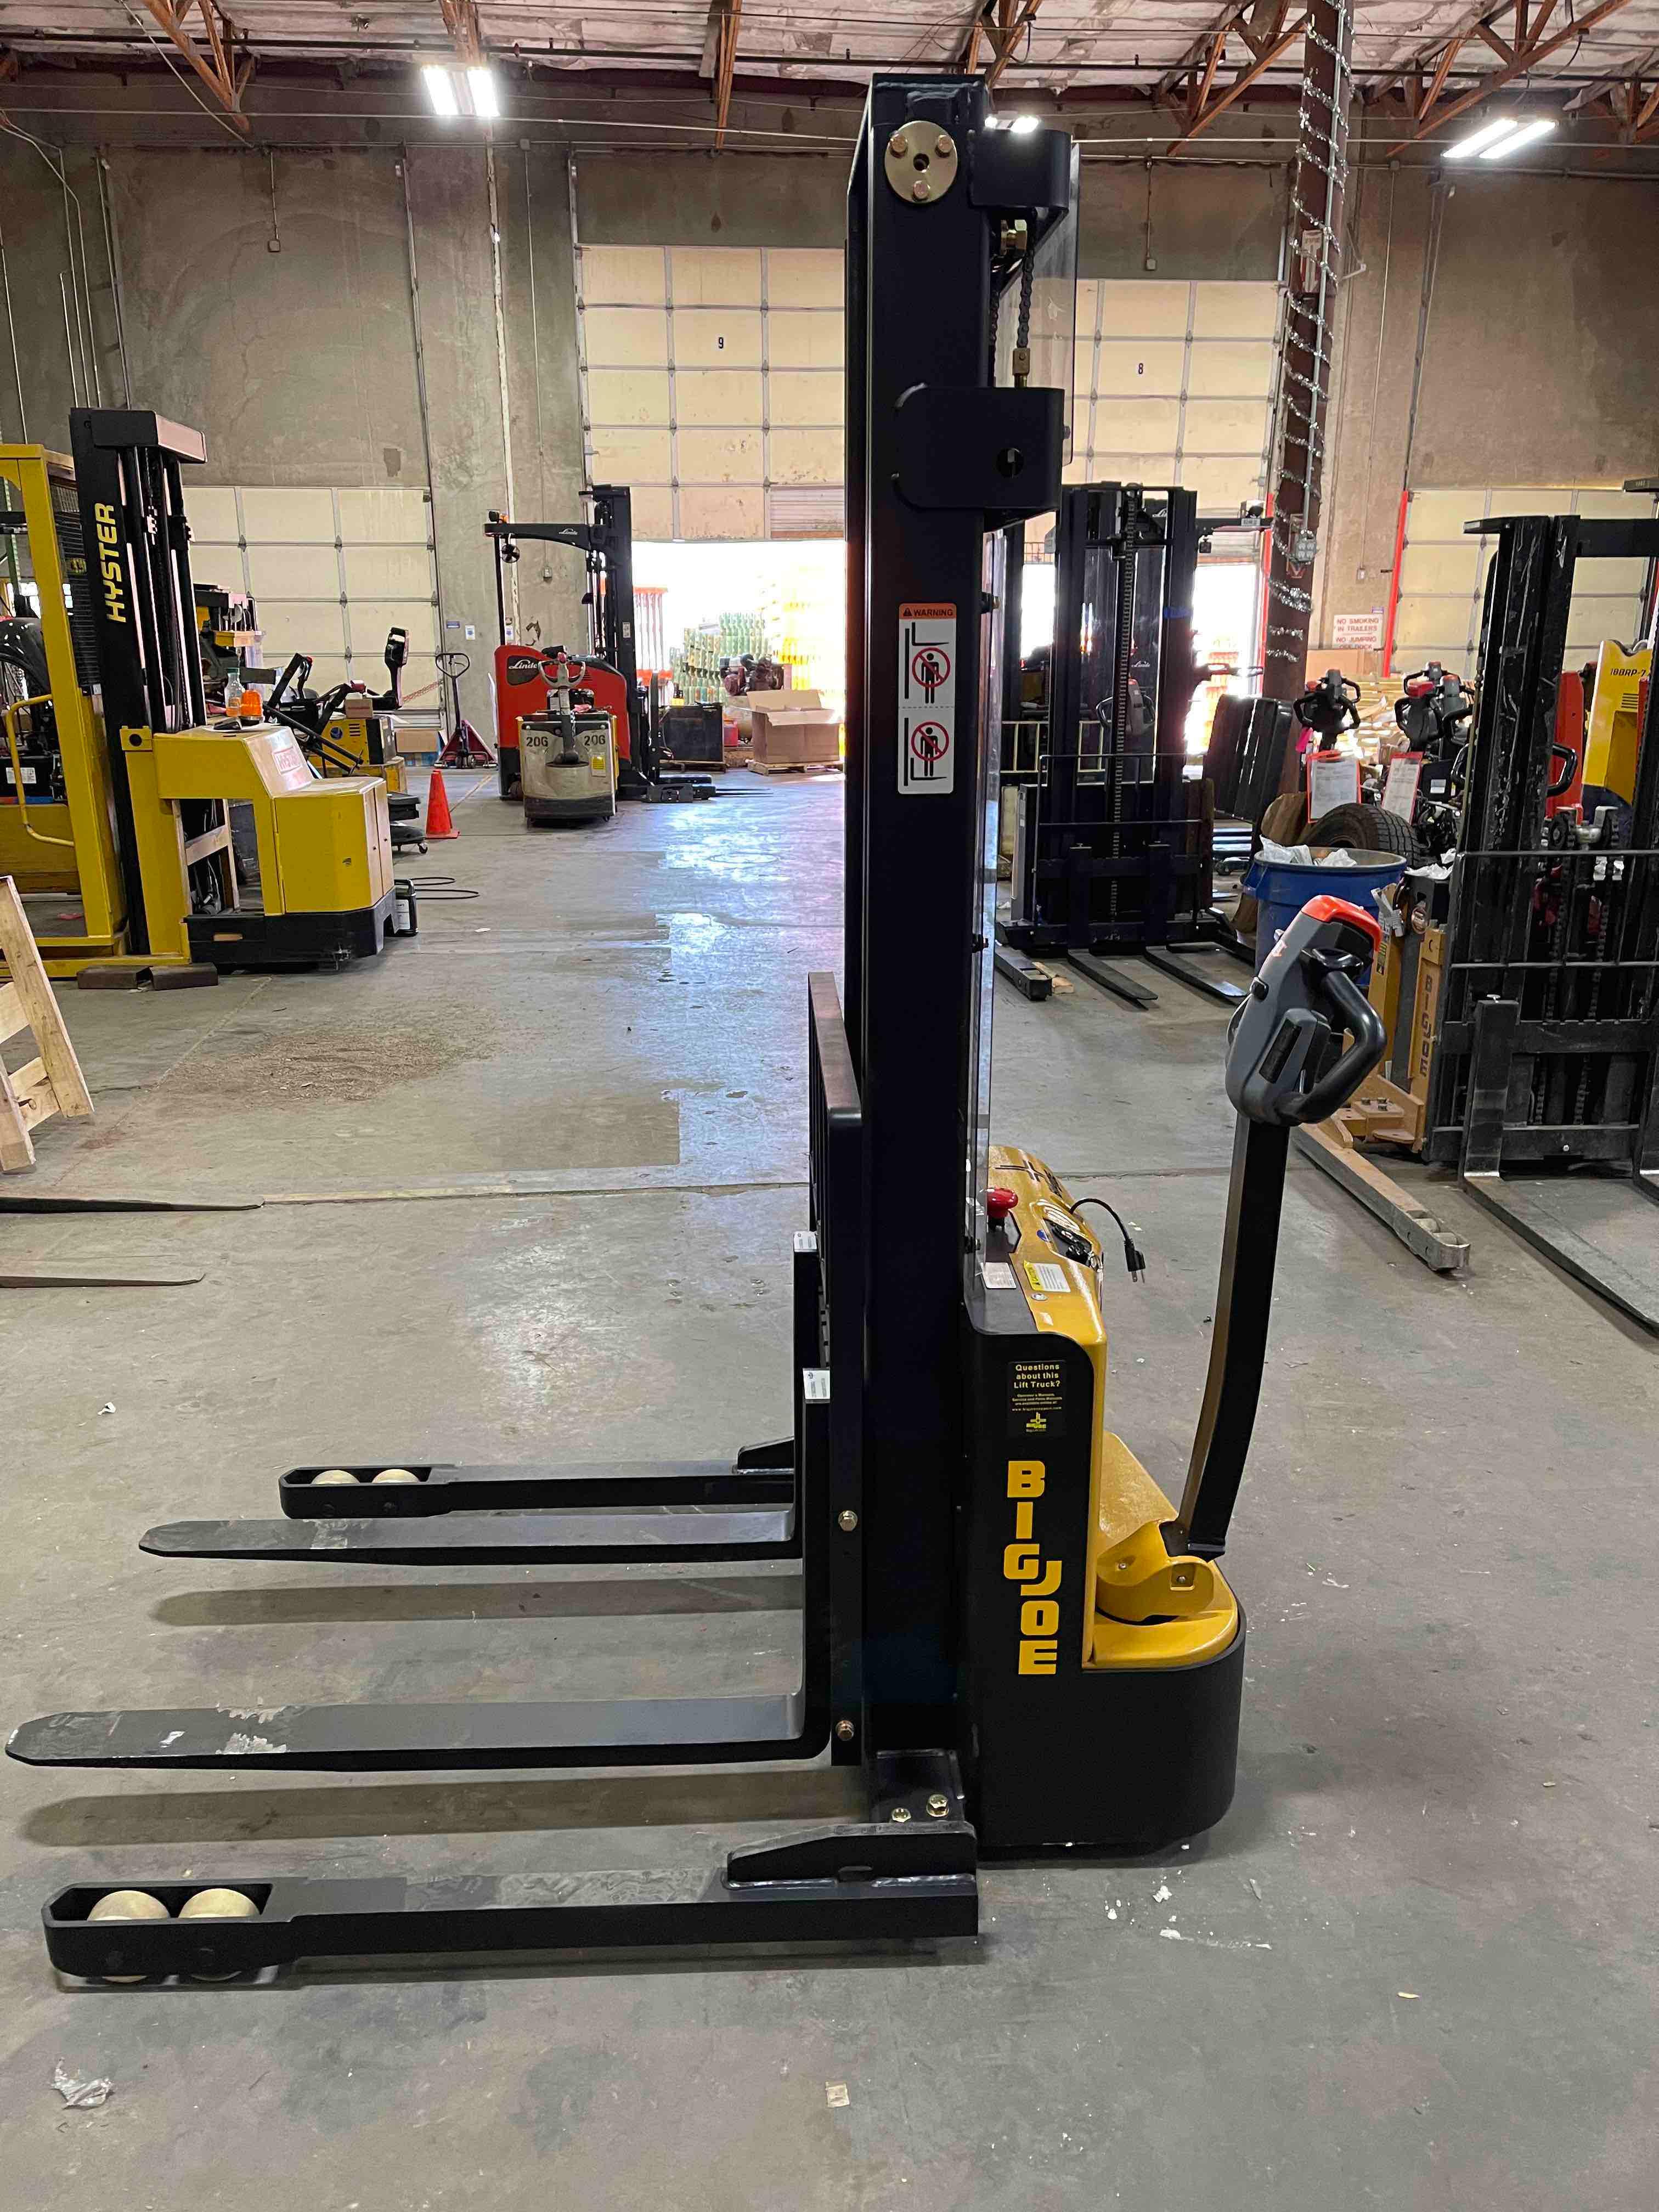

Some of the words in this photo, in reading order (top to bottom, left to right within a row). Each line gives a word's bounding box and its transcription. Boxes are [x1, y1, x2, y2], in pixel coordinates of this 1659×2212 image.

[718, 337, 724, 349] 9
[1138, 363, 1143, 374] 8
[94, 503, 127, 623] HYSTER
[526, 737, 549, 747] 20G
[584, 735, 606, 746] 20G
